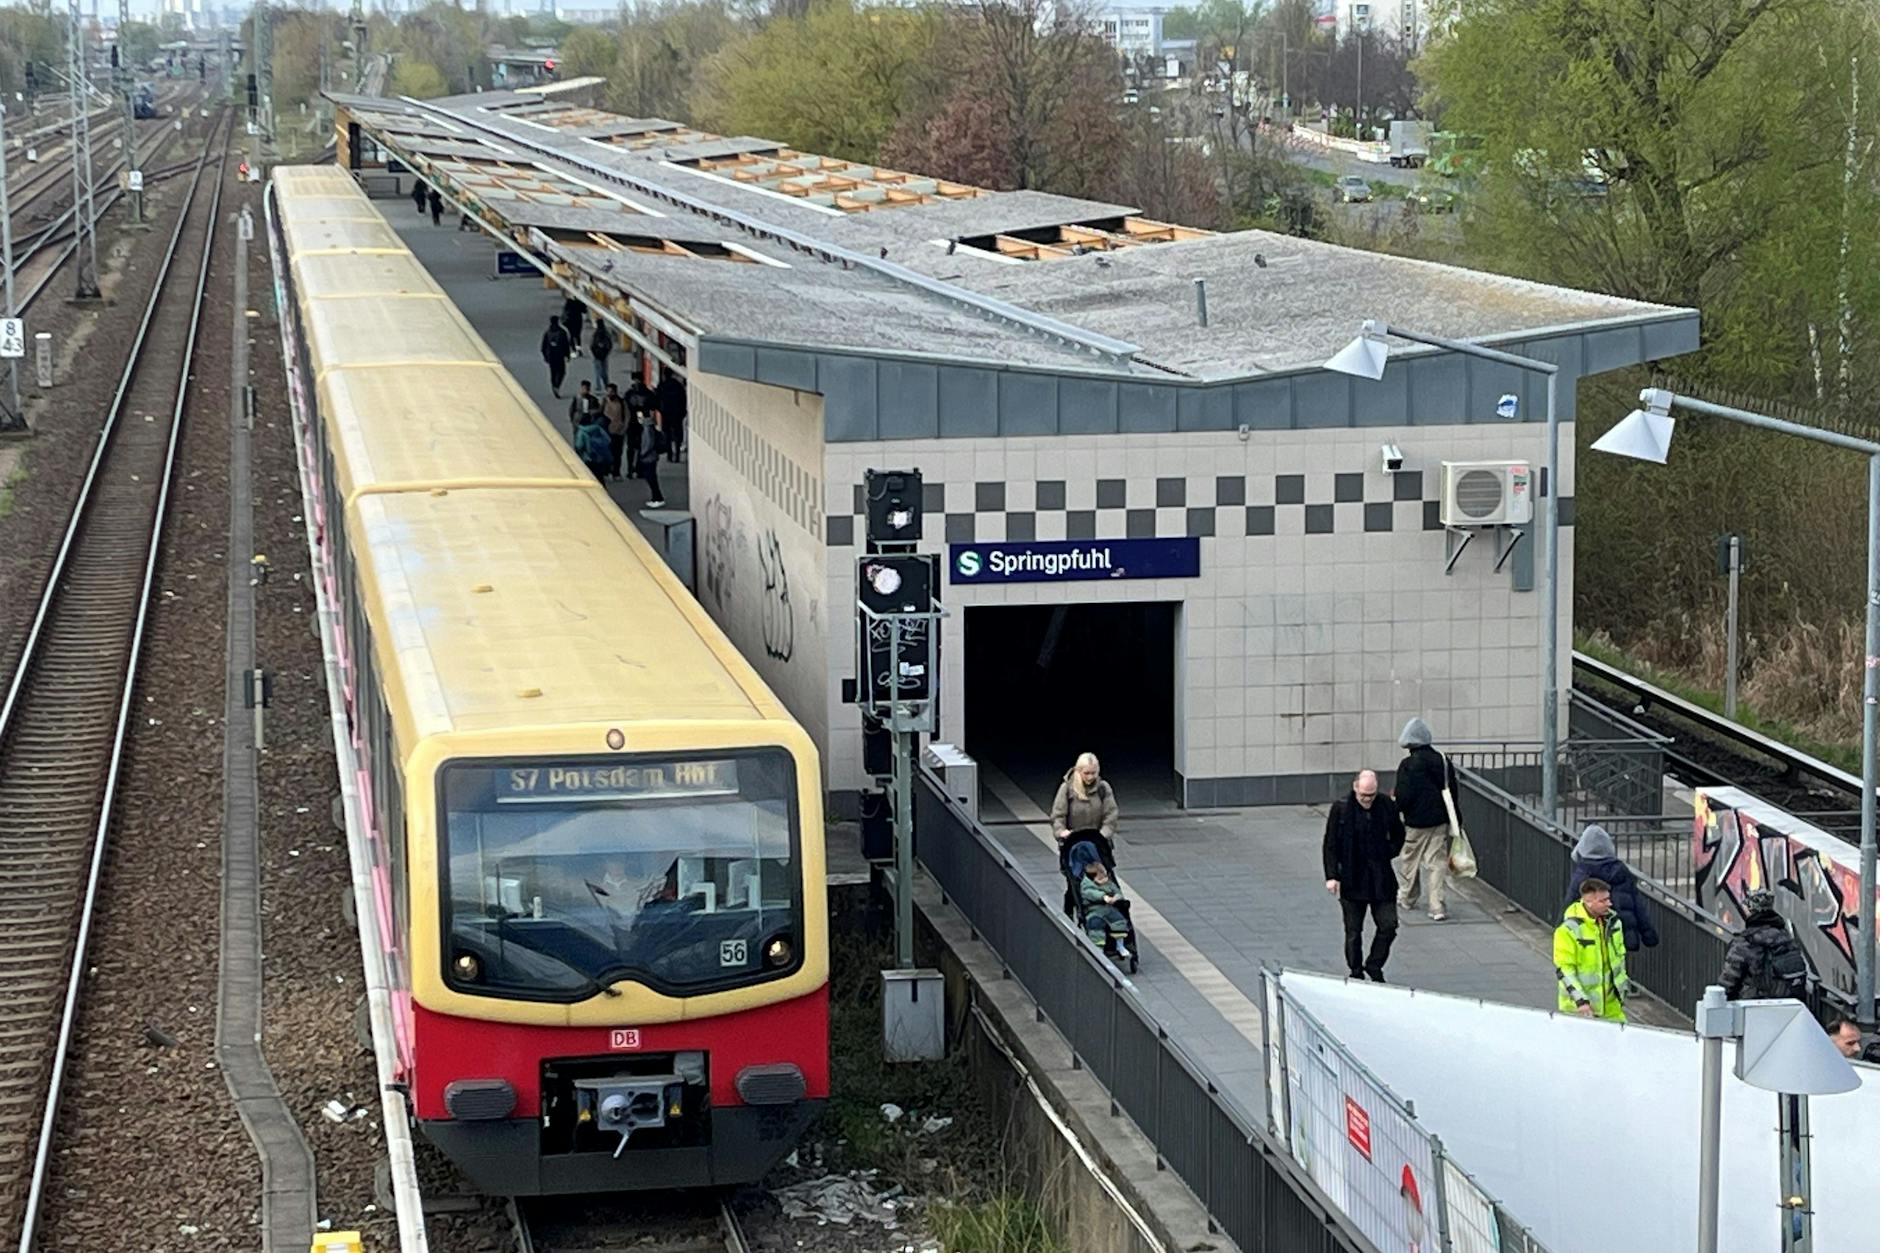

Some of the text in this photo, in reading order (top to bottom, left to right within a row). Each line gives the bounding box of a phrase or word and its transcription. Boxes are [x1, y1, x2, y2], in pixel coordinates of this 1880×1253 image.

[6, 321, 16, 336] 8
[989, 548, 1112, 576] Springpfuhl
[511, 768, 539, 791] S7
[550, 766, 665, 790] Potsdam
[722, 942, 745, 963] 56
[614, 1031, 637, 1046] DB
